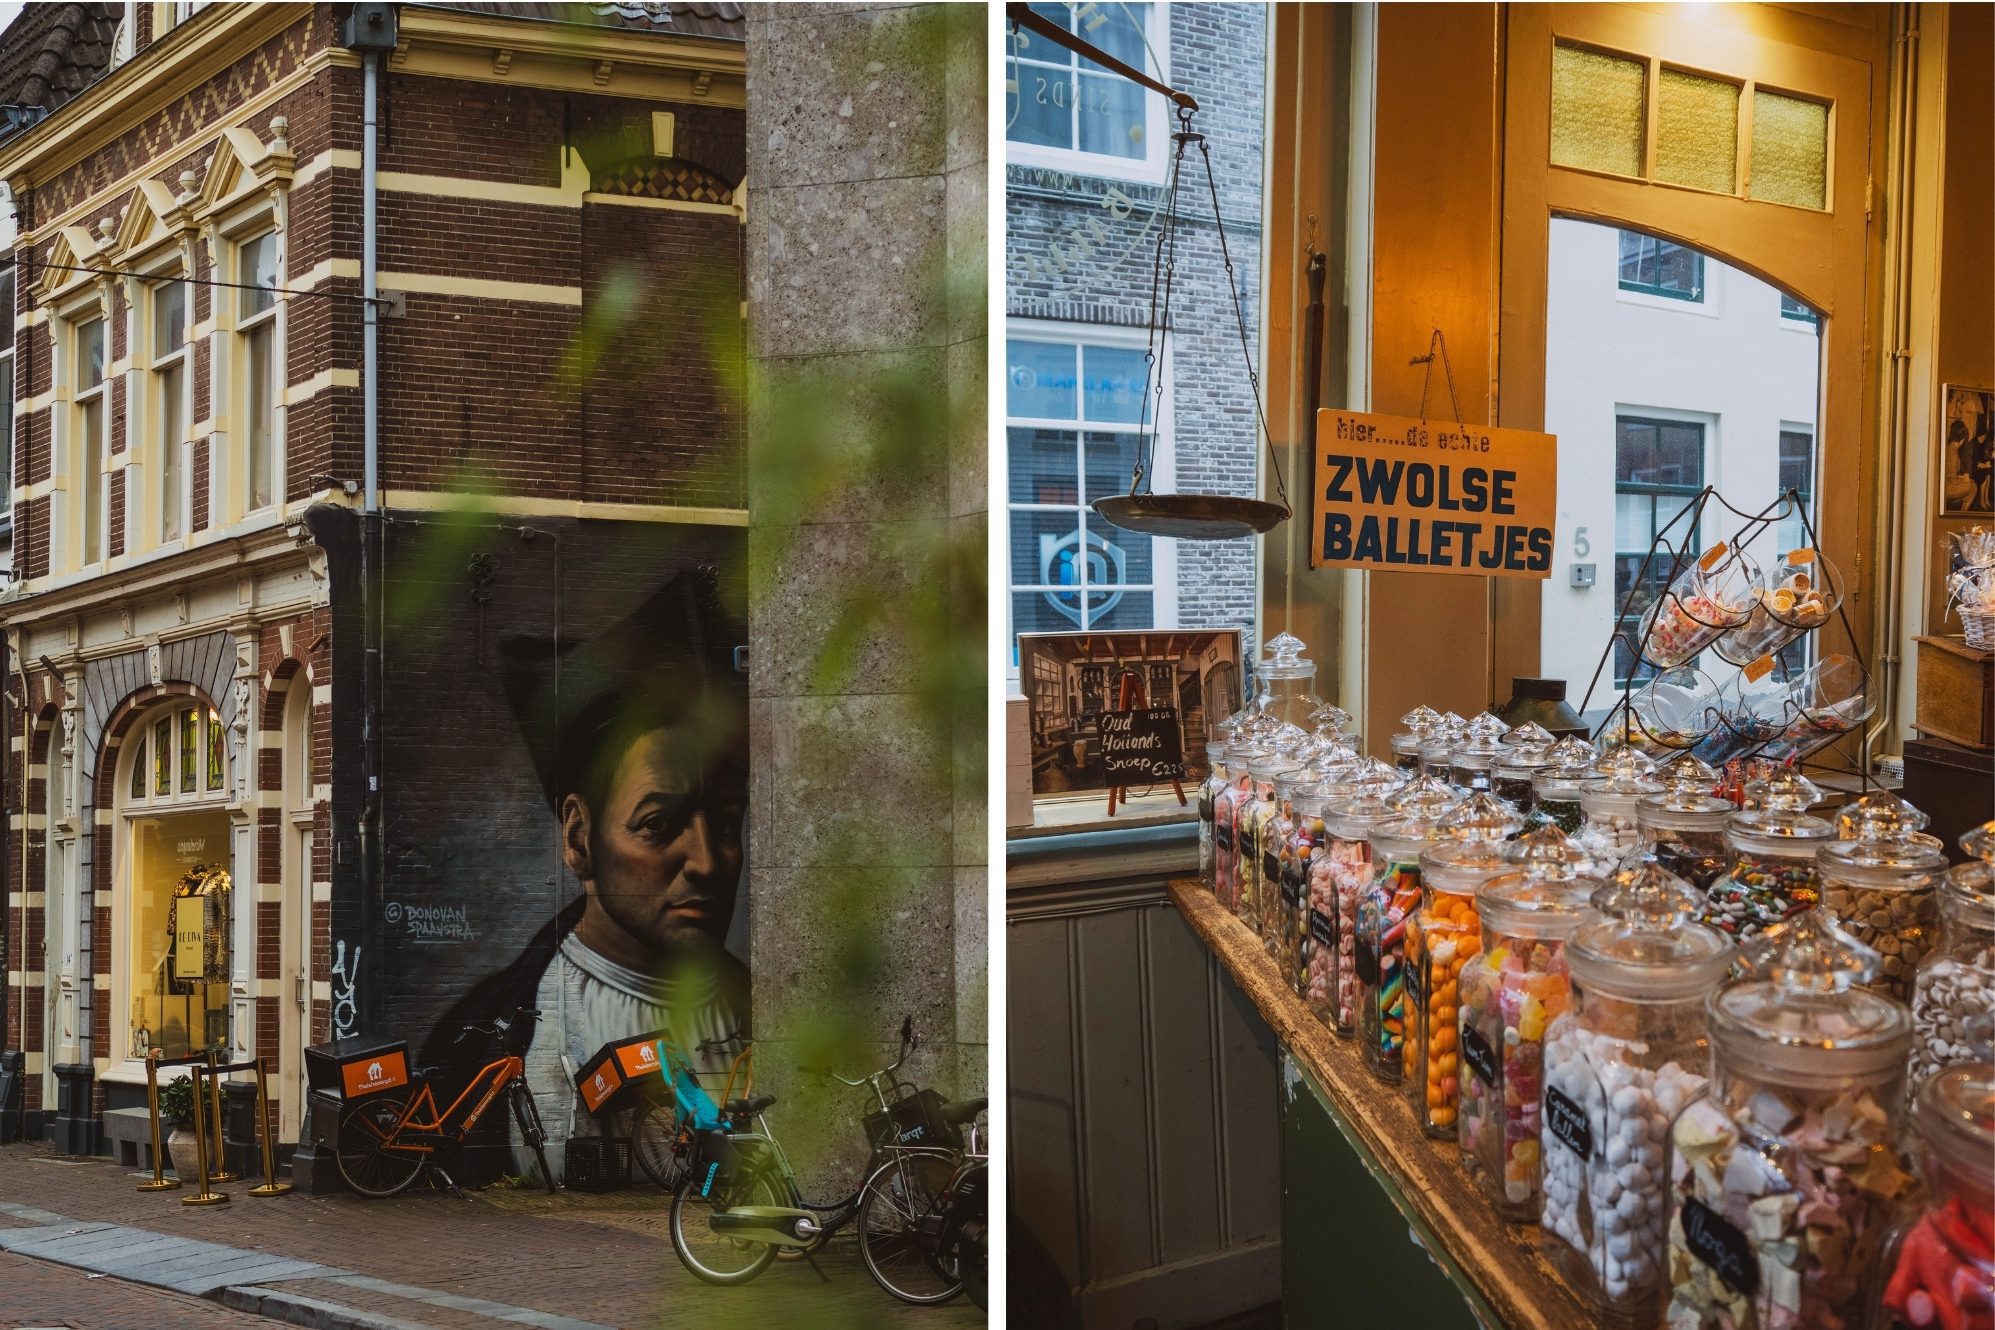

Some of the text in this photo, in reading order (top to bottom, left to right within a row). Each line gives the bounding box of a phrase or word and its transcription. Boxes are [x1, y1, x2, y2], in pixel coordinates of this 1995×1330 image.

[1326, 454, 1517, 515] ZWOLSE
[1323, 512, 1552, 571] BALLETJES
[1574, 526, 1590, 558] 5
[1102, 712, 1134, 732] Oud
[1105, 755, 1151, 771] Snoep
[899, 1125, 924, 1143] arqt
